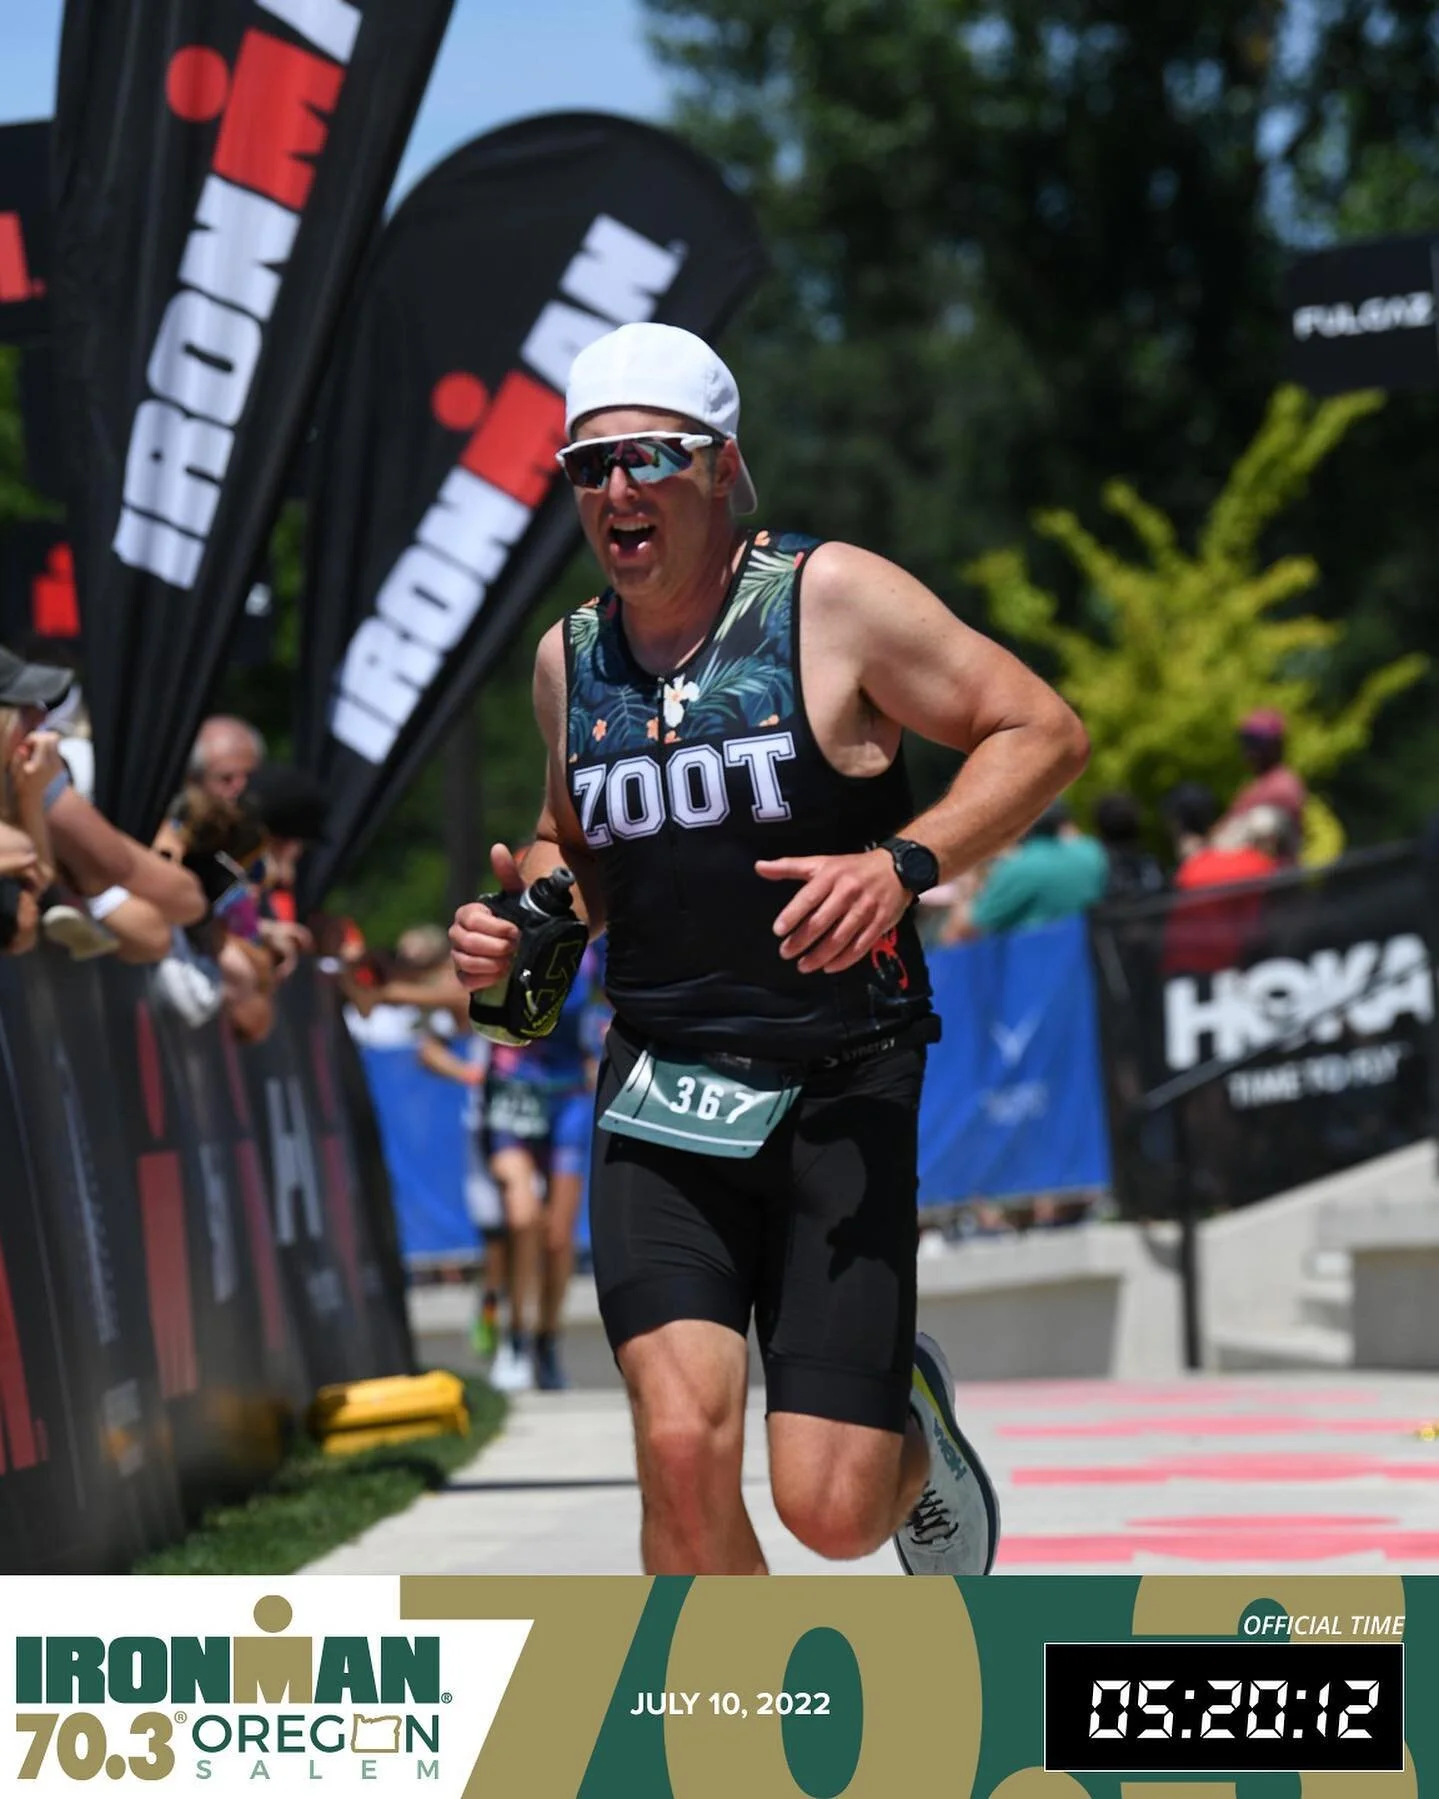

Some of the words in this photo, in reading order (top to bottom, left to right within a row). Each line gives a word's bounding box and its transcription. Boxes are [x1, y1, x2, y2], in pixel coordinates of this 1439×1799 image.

[573, 731, 797, 849] ZOOT
[1164, 932, 1435, 1070] HOKA
[669, 1066, 754, 1124] 367
